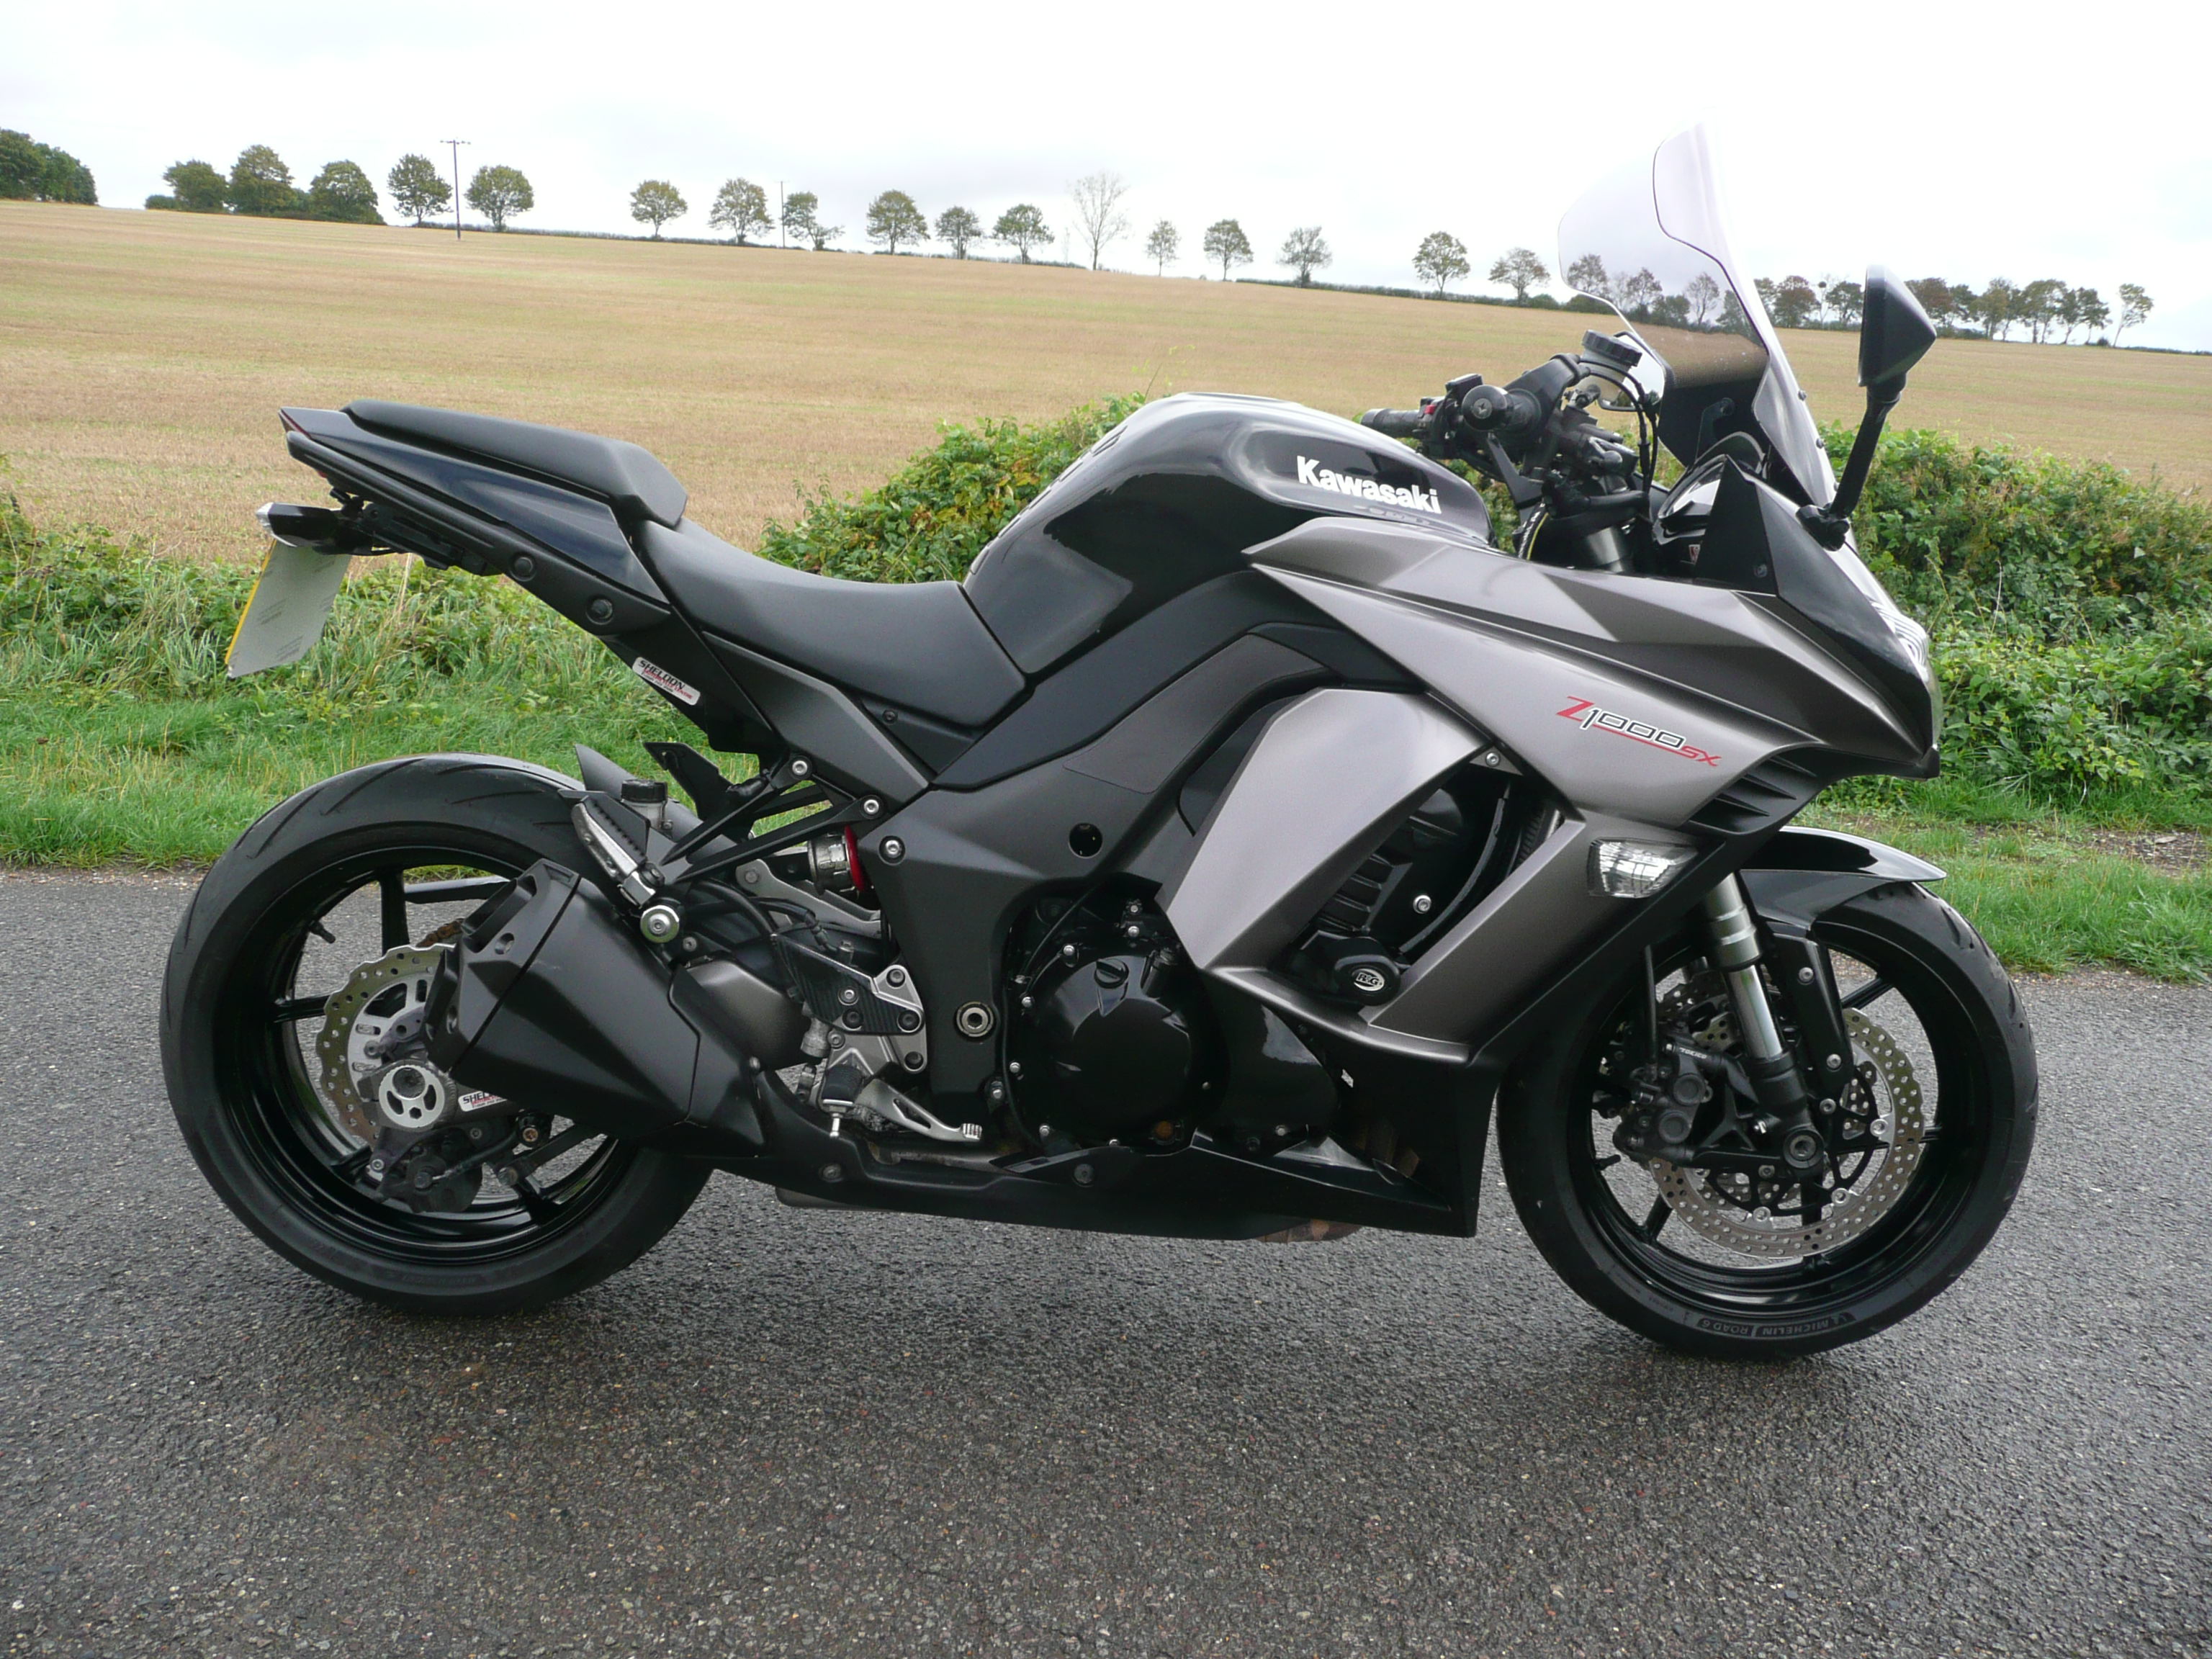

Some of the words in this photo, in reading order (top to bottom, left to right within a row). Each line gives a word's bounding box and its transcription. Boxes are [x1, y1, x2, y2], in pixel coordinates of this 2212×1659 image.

[1297, 455, 1442, 514] Kawasaki
[638, 660, 685, 689] SHELDON
[1555, 696, 1722, 767] Z1000SX
[1702, 1319, 1710, 1328] 6
[1713, 1323, 1749, 1336] ROAD
[1762, 1318, 1830, 1336] MICHELIN
